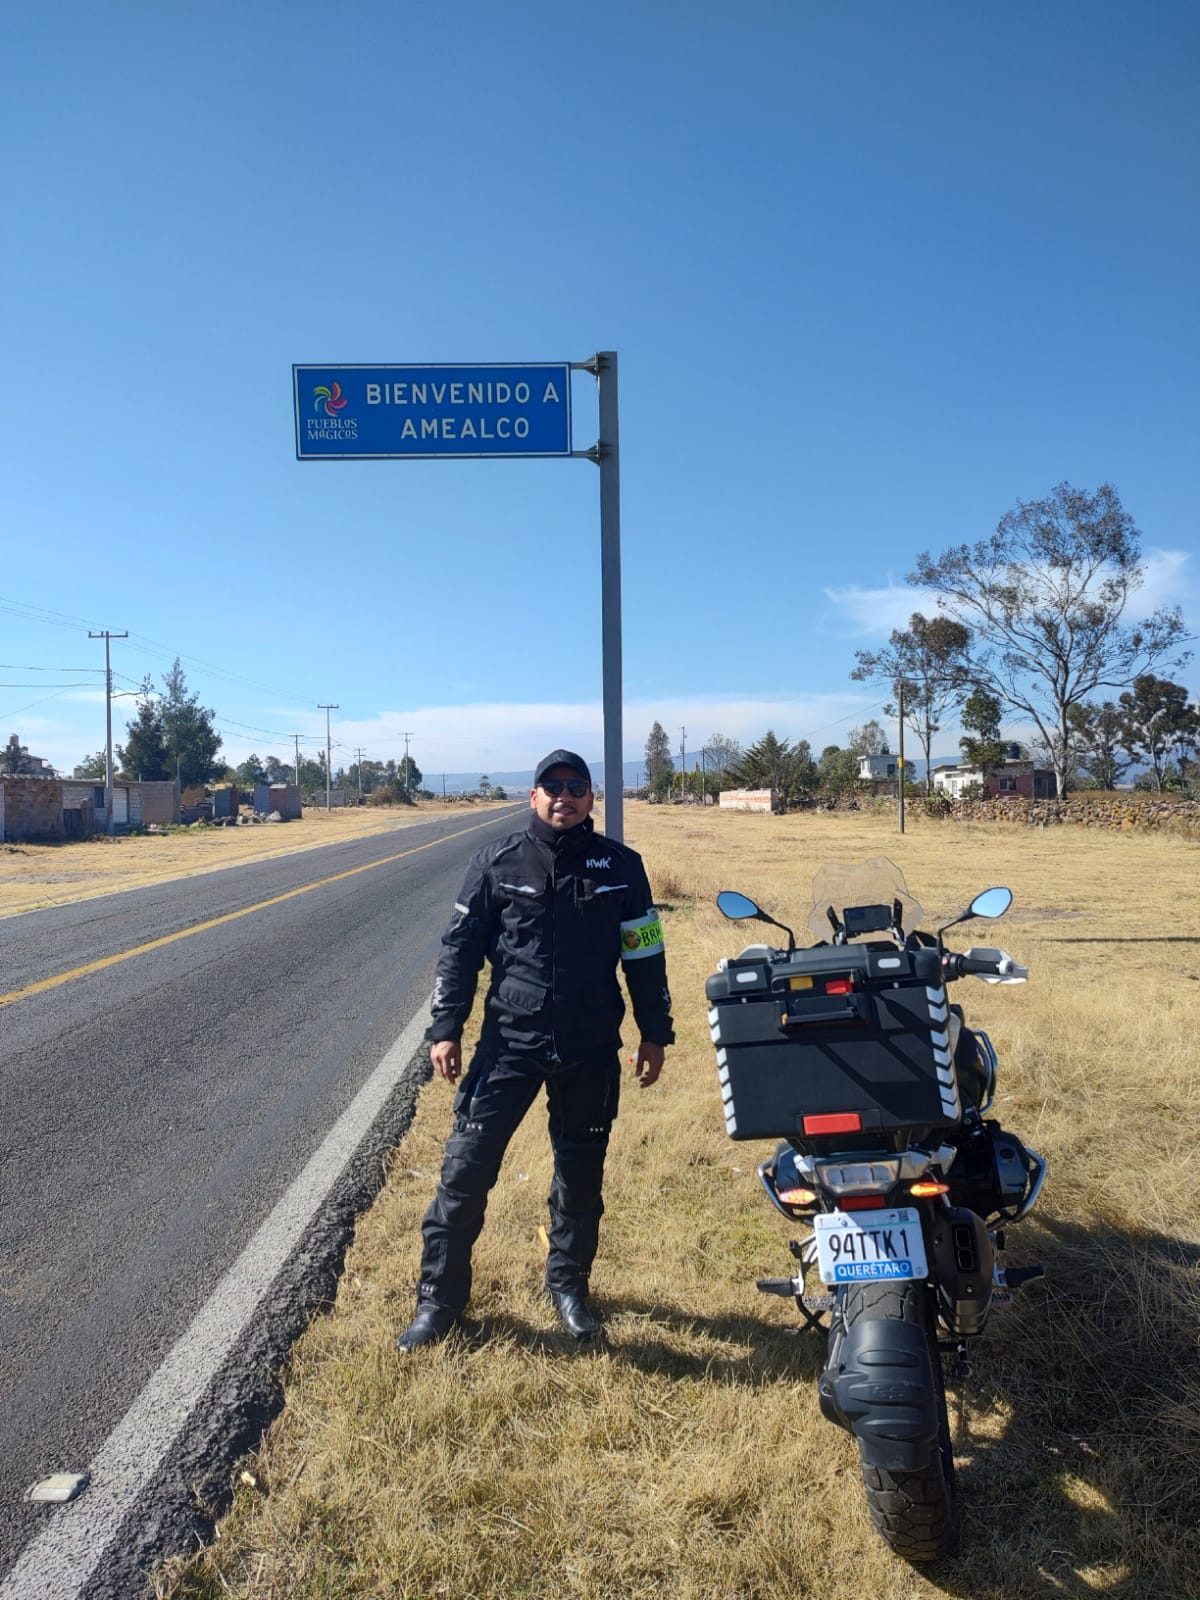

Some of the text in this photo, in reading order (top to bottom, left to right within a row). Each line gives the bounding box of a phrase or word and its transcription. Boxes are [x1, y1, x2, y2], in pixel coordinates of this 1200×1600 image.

[366, 382, 560, 405] BIENVENIDO A
[307, 418, 358, 429] PUEBLOS
[401, 417, 530, 440] AMEALCO
[585, 857, 611, 869] HWK
[828, 1228, 910, 1262] 94TTK1
[837, 1262, 909, 1277] QUERÉTARO
